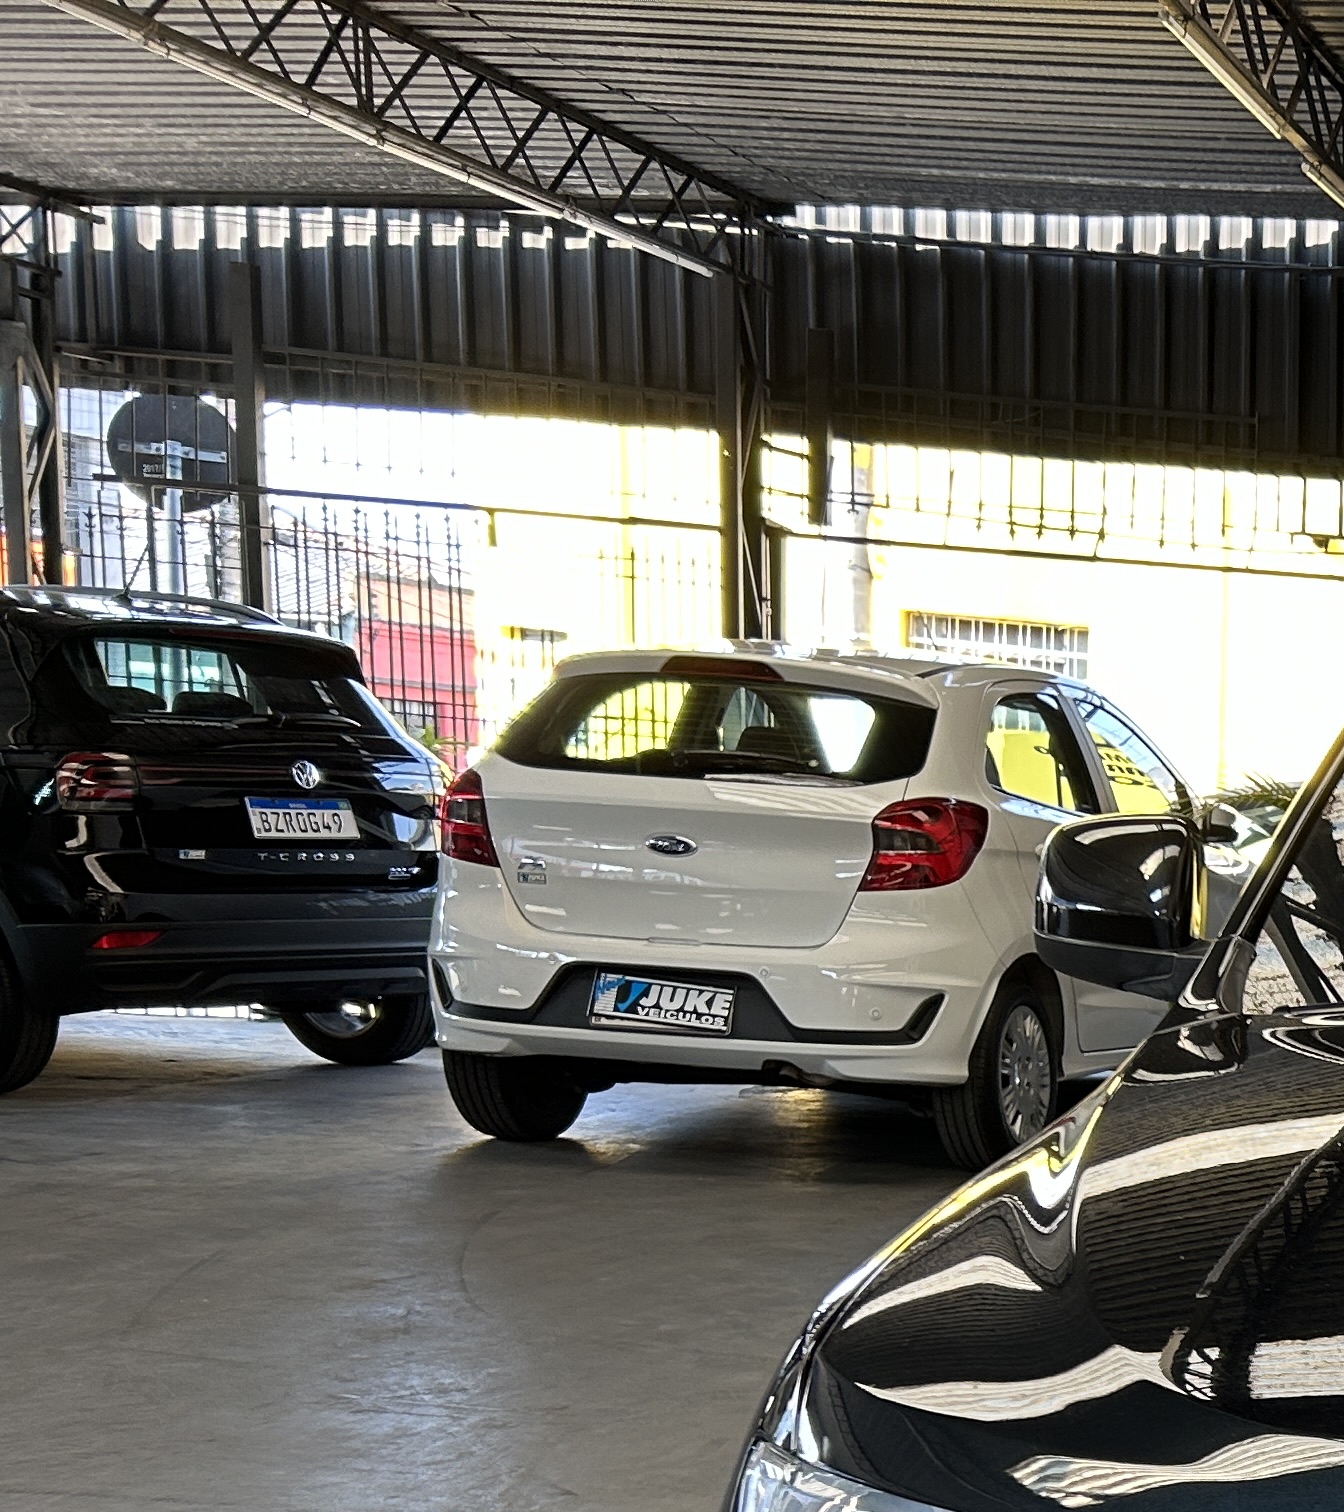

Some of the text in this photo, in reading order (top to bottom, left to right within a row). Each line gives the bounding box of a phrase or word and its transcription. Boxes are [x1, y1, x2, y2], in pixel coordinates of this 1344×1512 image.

[257, 852, 355, 861] T-CROSS
[639, 984, 734, 1017] JUKE
[637, 1006, 725, 1026] VEICULOS
